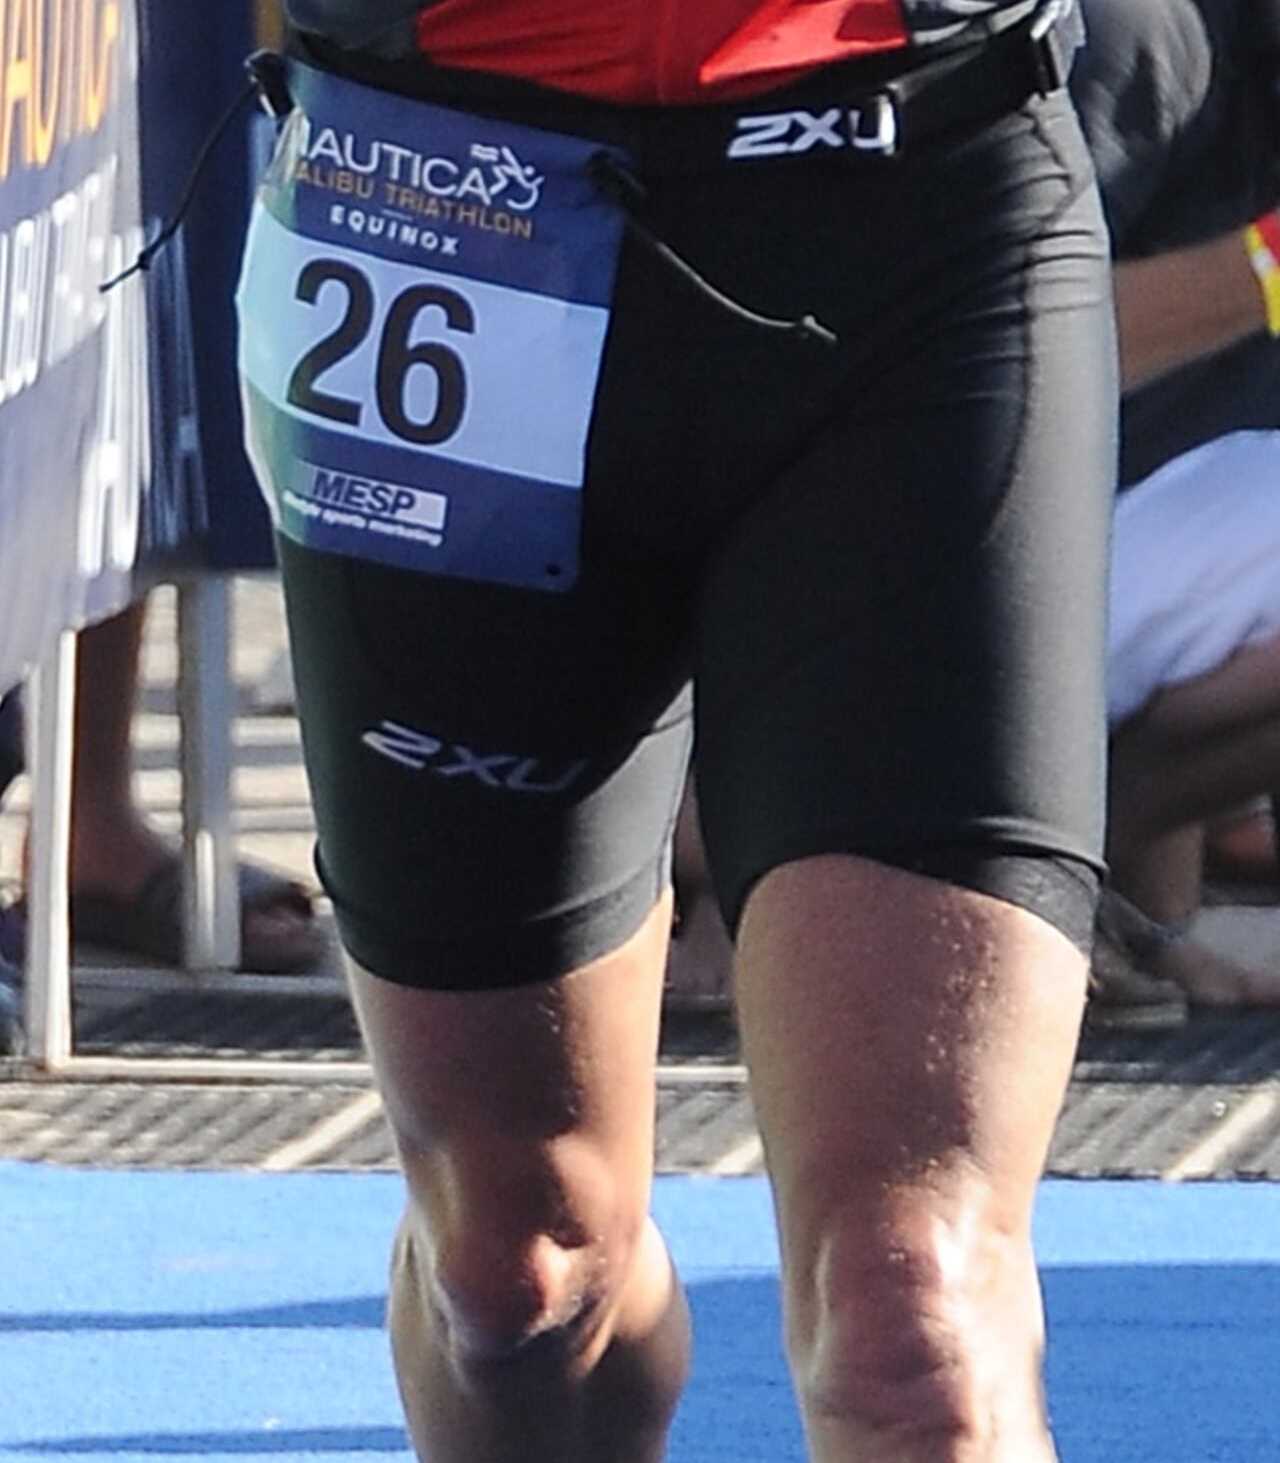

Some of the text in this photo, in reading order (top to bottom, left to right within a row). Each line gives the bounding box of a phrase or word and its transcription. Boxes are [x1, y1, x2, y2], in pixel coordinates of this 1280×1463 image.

[294, 159, 534, 239] ALIBU TRIATHLON
[300, 127, 491, 206] AUTICA
[329, 204, 459, 255] EQUINOX
[286, 258, 477, 445] 26
[313, 469, 417, 516] MESP
[361, 720, 588, 794] 2XU
